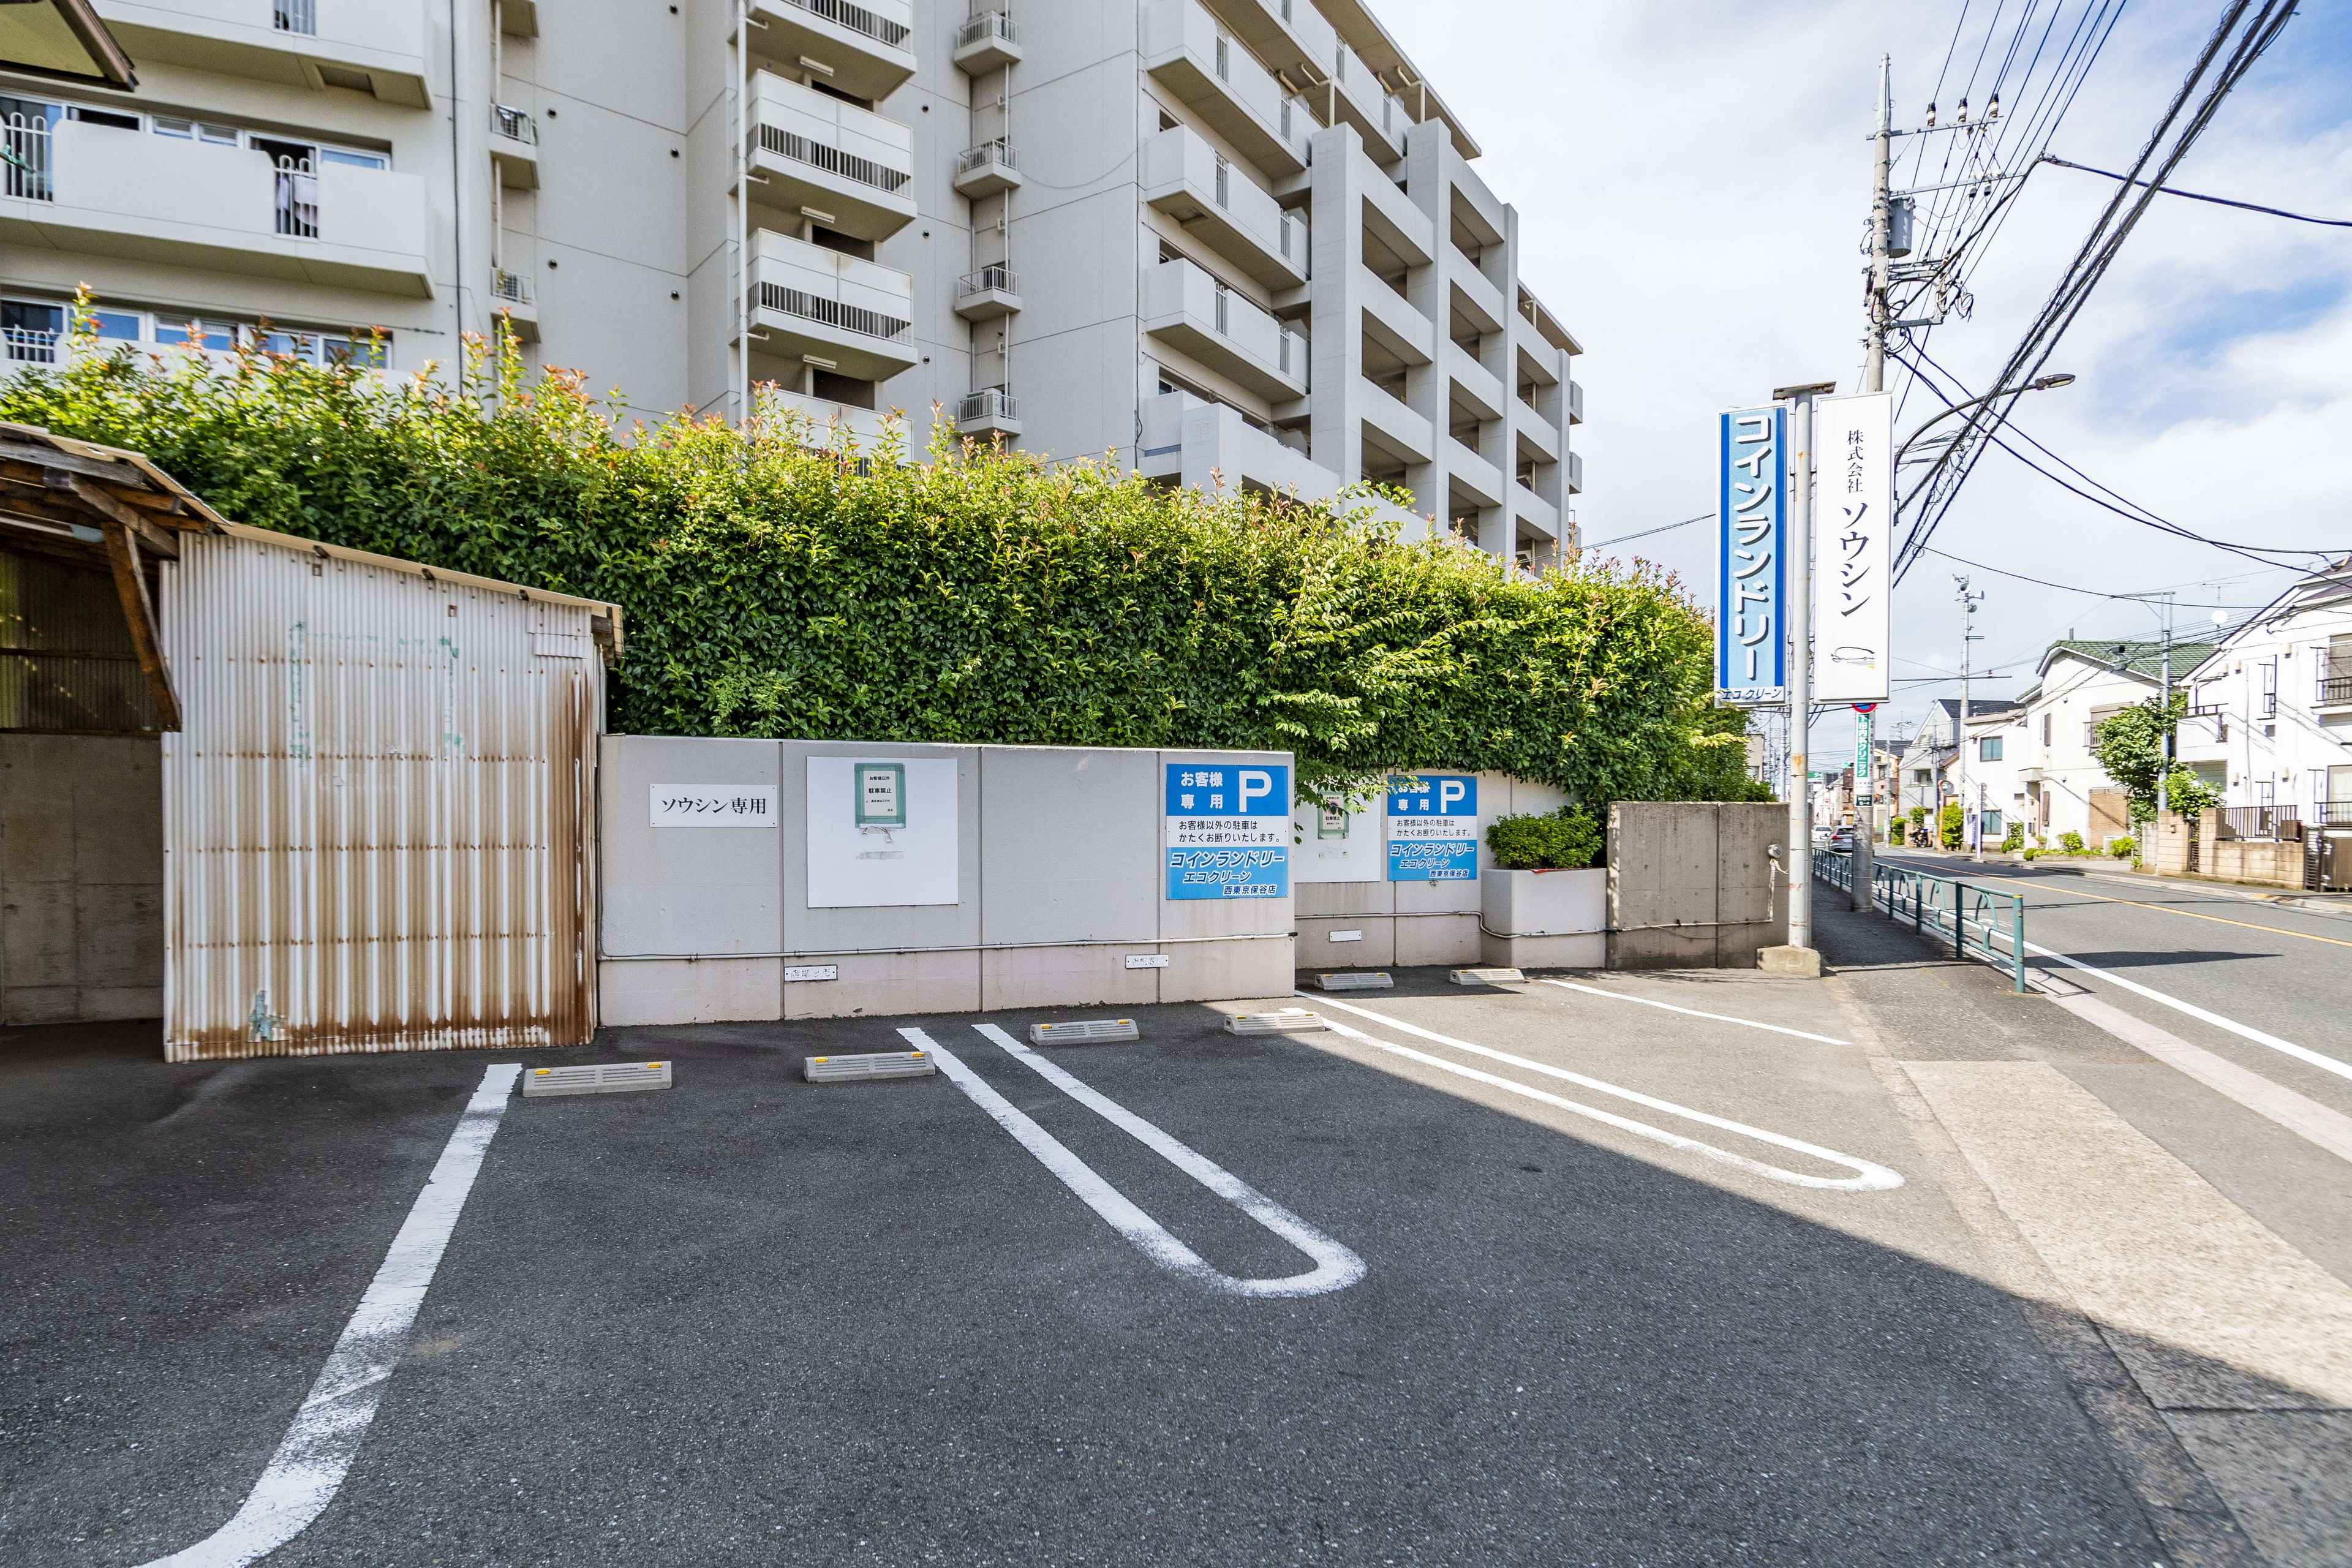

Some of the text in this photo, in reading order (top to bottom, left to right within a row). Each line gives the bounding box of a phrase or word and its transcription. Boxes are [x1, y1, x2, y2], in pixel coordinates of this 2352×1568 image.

[1840, 429, 1871, 617] 株式会社 ソウシン
[1733, 415, 1771, 680] コインランドリー
[1181, 771, 1223, 787] お客様
[1239, 771, 1272, 813] P
[1441, 780, 1465, 813] P
[662, 797, 766, 814] ソウシン専用
[1181, 793, 1223, 809] 専用
[1179, 820, 1257, 830] お客様以外の駐車は
[1179, 832, 1280, 843] かたくお断りいたします。
[1390, 843, 1474, 856] コインランドリー
[1170, 851, 1285, 869] コインランドリー
[1400, 858, 1450, 869] エコクリーン
[1183, 870, 1251, 884] エコクリーン
[1429, 869, 1469, 878] 西東京保谷店
[1223, 884, 1278, 895] 西東京保谷店
